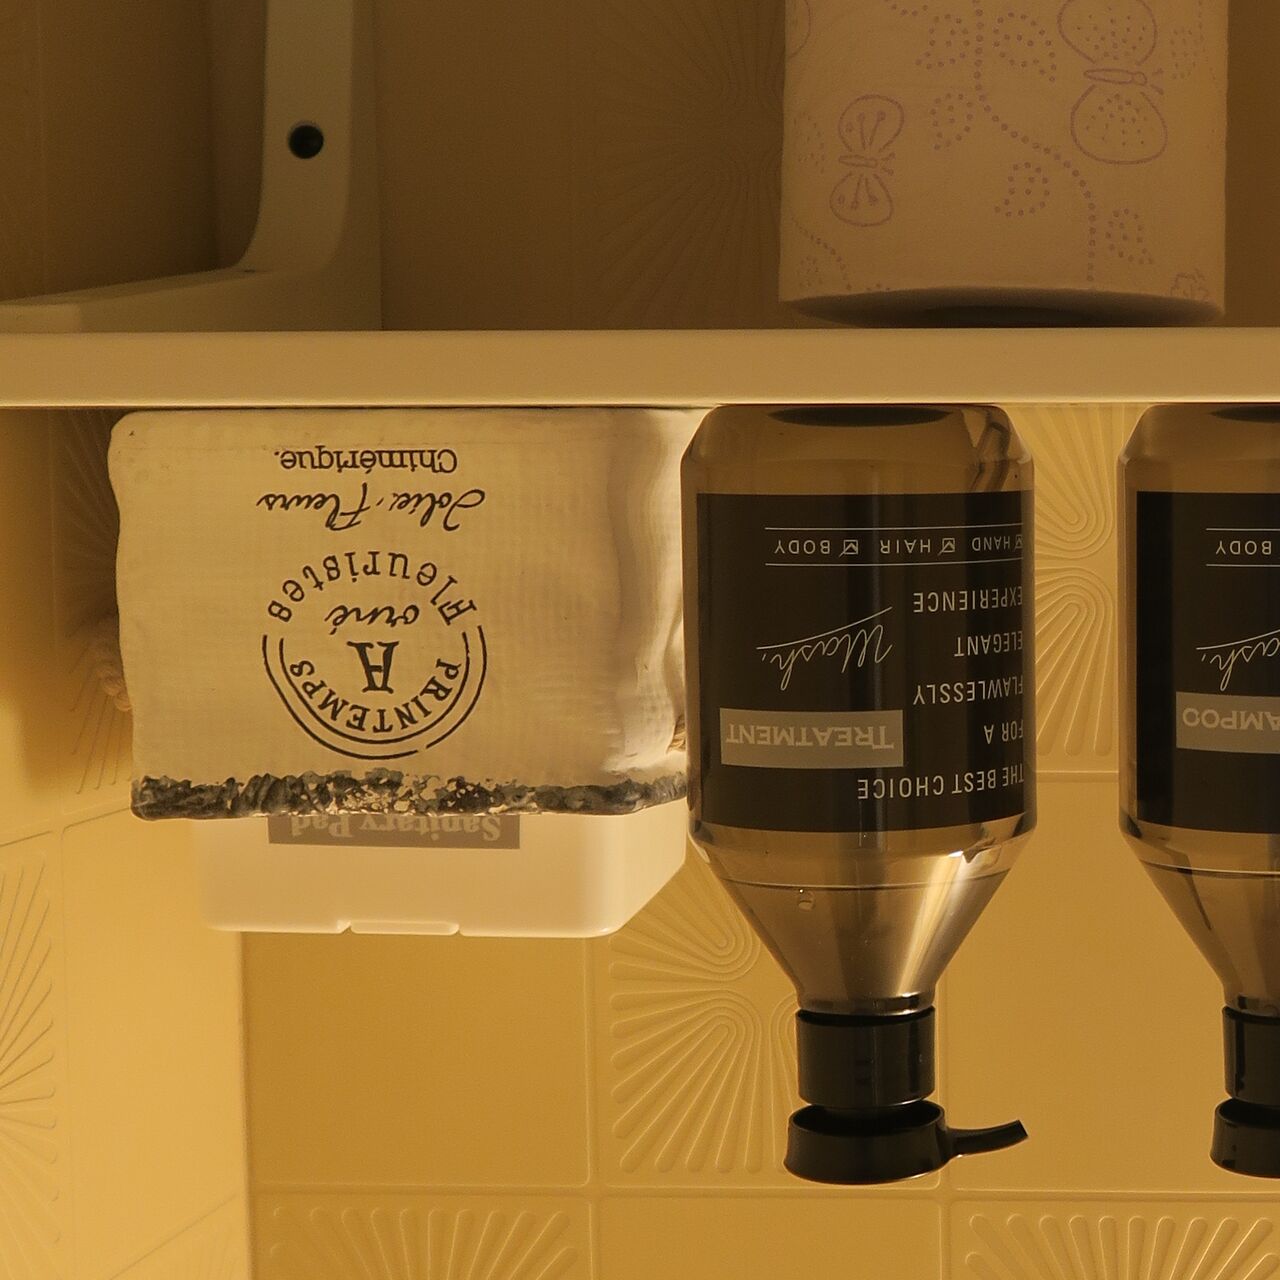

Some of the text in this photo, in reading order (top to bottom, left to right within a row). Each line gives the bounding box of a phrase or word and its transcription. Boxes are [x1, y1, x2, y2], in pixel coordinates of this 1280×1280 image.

[274, 445, 458, 483] Chimérique.
[775, 535, 1010, 554] HAND HAIR BODY
[1216, 540, 1272, 555] BODY
[268, 551, 477, 625] Fleuristes
[913, 586, 1022, 613] EXPERIENCE
[324, 604, 420, 635] orné
[954, 631, 1023, 657] ELEGANT
[346, 640, 399, 694] A
[289, 659, 462, 733] PRINTEMPS
[913, 675, 1023, 705] FLAWLESSLY
[984, 720, 1023, 744] FOR A
[857, 763, 1024, 799] THE BEST CHOICE
